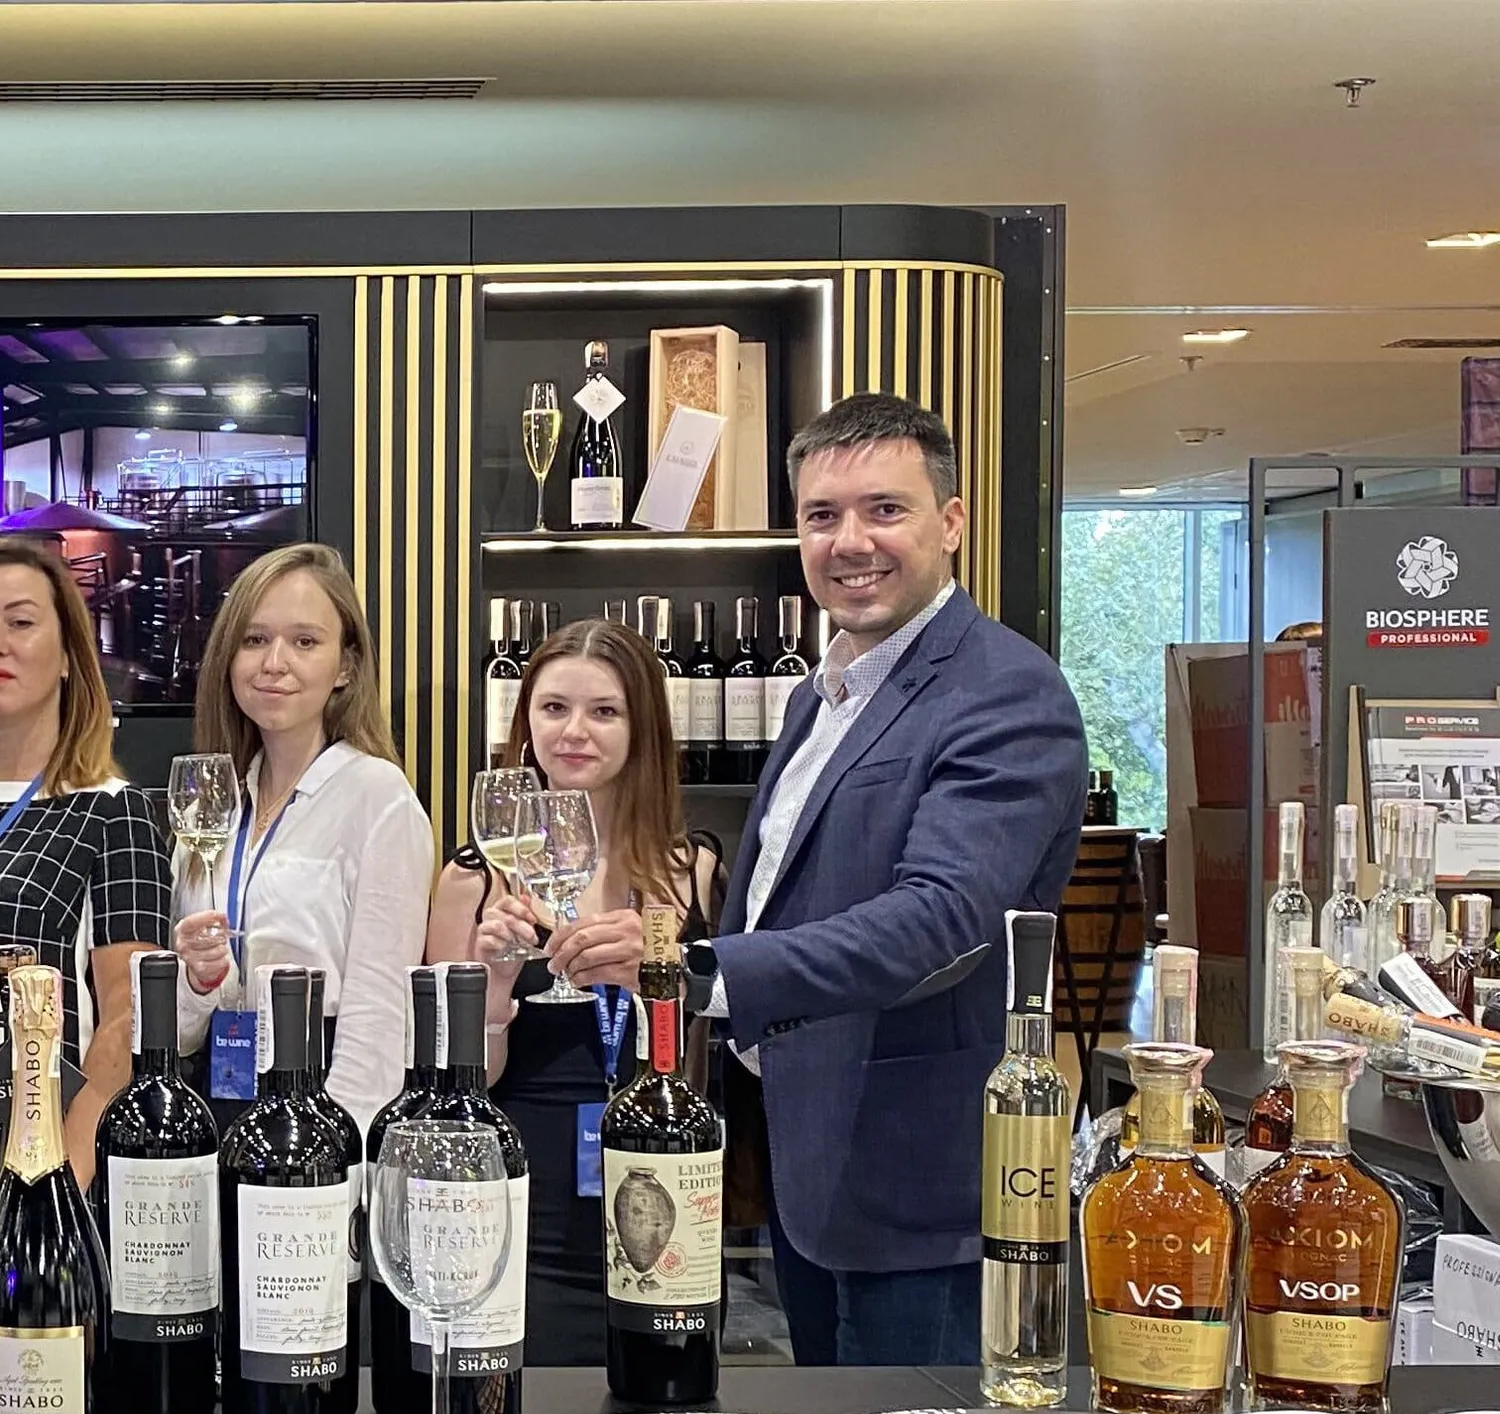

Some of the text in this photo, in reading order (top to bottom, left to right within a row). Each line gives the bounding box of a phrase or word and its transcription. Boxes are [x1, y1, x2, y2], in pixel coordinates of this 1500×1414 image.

[1366, 609, 1489, 628] BIOSPHERE
[1380, 632, 1477, 644] PROFESSIONAL
[26, 1039, 41, 1120] SHABO
[1001, 1165, 1055, 1198] ICE
[125, 1200, 202, 1211] GRANDE
[1002, 1199, 1055, 1209] WINE
[125, 1210, 202, 1227] RESERVE
[423, 1223, 501, 1235] GRANDE
[257, 1230, 338, 1243] GRANDE
[124, 1240, 191, 1249] CHARDONNAY
[257, 1242, 338, 1260] RESERVE
[124, 1248, 184, 1257] SAUVIGNON
[999, 1249, 1049, 1262] SHABO
[124, 1256, 155, 1264] BLANC
[256, 1275, 327, 1284] CHARDONNAY
[256, 1283, 320, 1292] SAUVIGNON
[1279, 1278, 1361, 1302] VSOP
[256, 1291, 291, 1300] BLANC
[1127, 1280, 1184, 1310] VS
[156, 1323, 204, 1337] SHABO
[653, 1318, 706, 1331] SHABO
[1130, 1319, 1183, 1335] SHABO
[1292, 1317, 1347, 1332] SHABO
[290, 1361, 337, 1378] SHABO
[458, 1357, 509, 1372] SHABO
